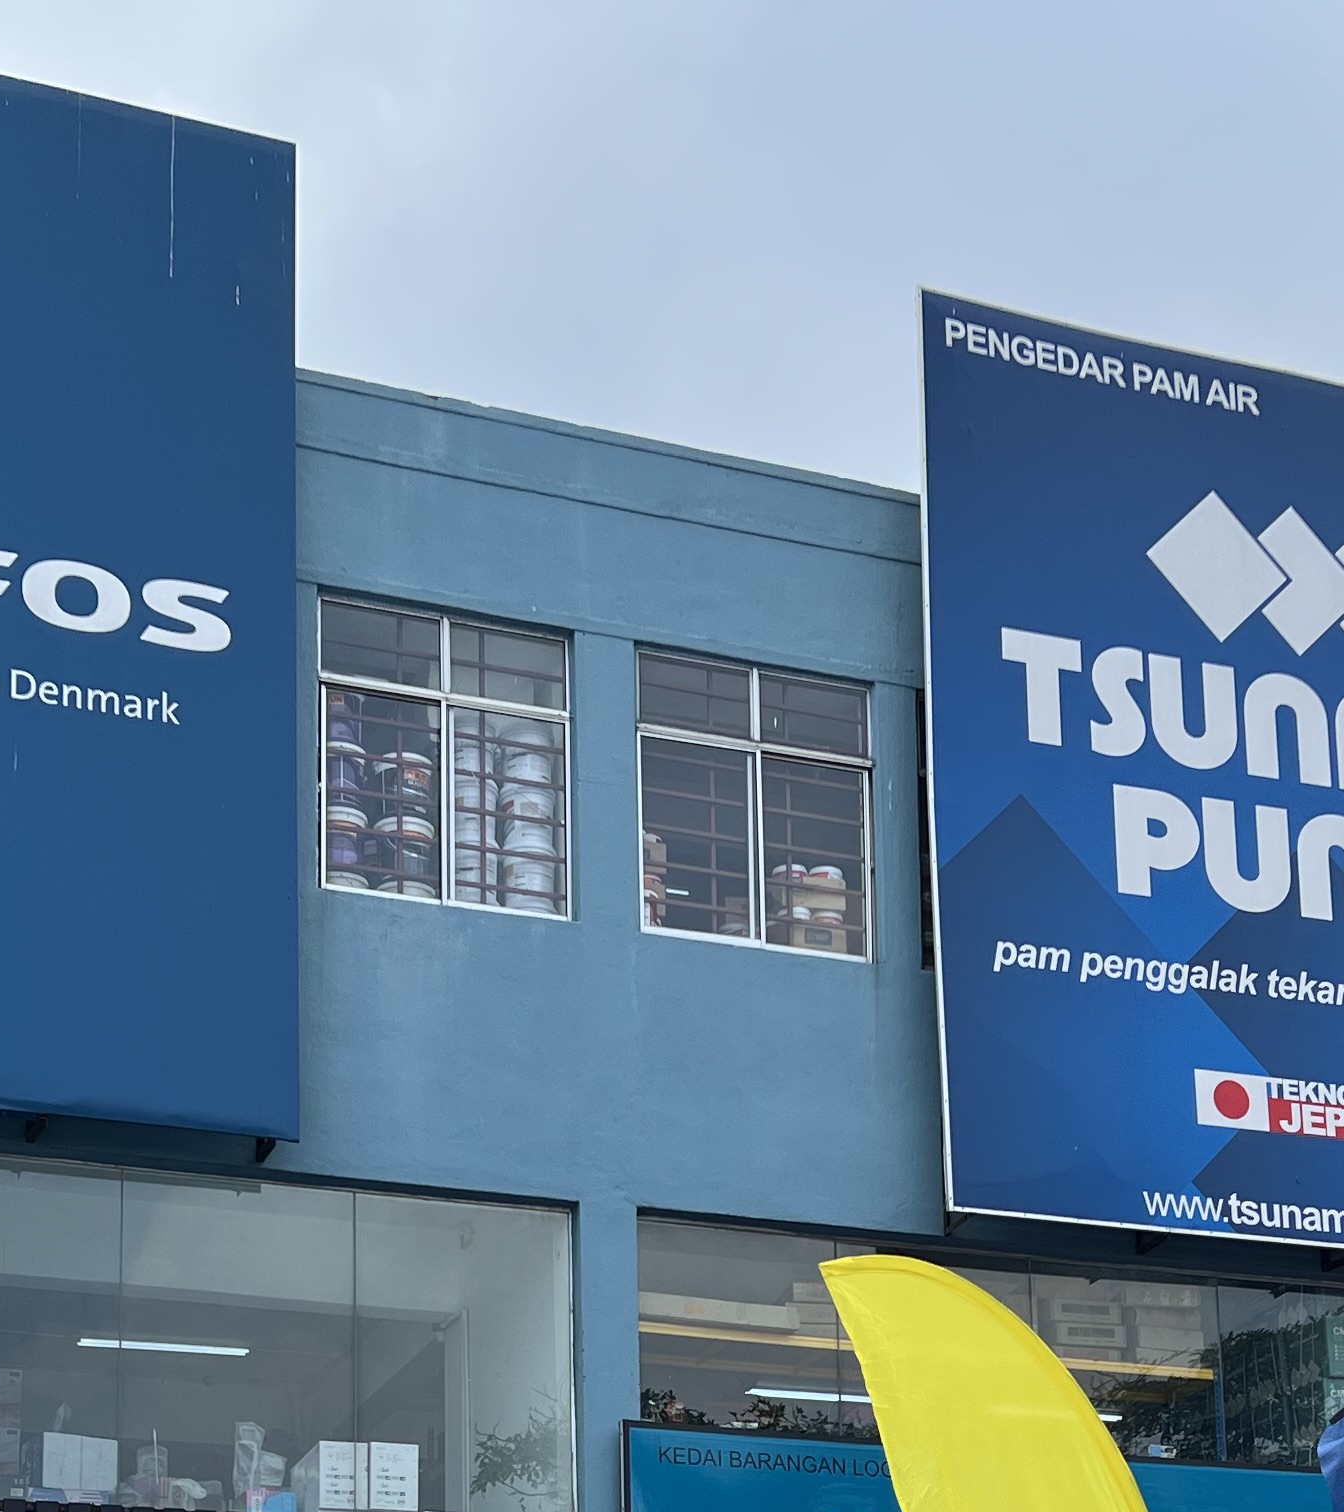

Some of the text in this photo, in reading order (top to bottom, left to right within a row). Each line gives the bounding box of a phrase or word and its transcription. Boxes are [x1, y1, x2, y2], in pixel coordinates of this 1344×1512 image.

[945, 317, 1260, 416] PENGEDAR PAM AIR
[10, 668, 180, 725] Denmark
[993, 937, 1071, 974] pam
[1079, 948, 1259, 996] penggalak
[658, 1446, 722, 1468] KEDAI
[729, 1451, 846, 1476] BARANGAN
